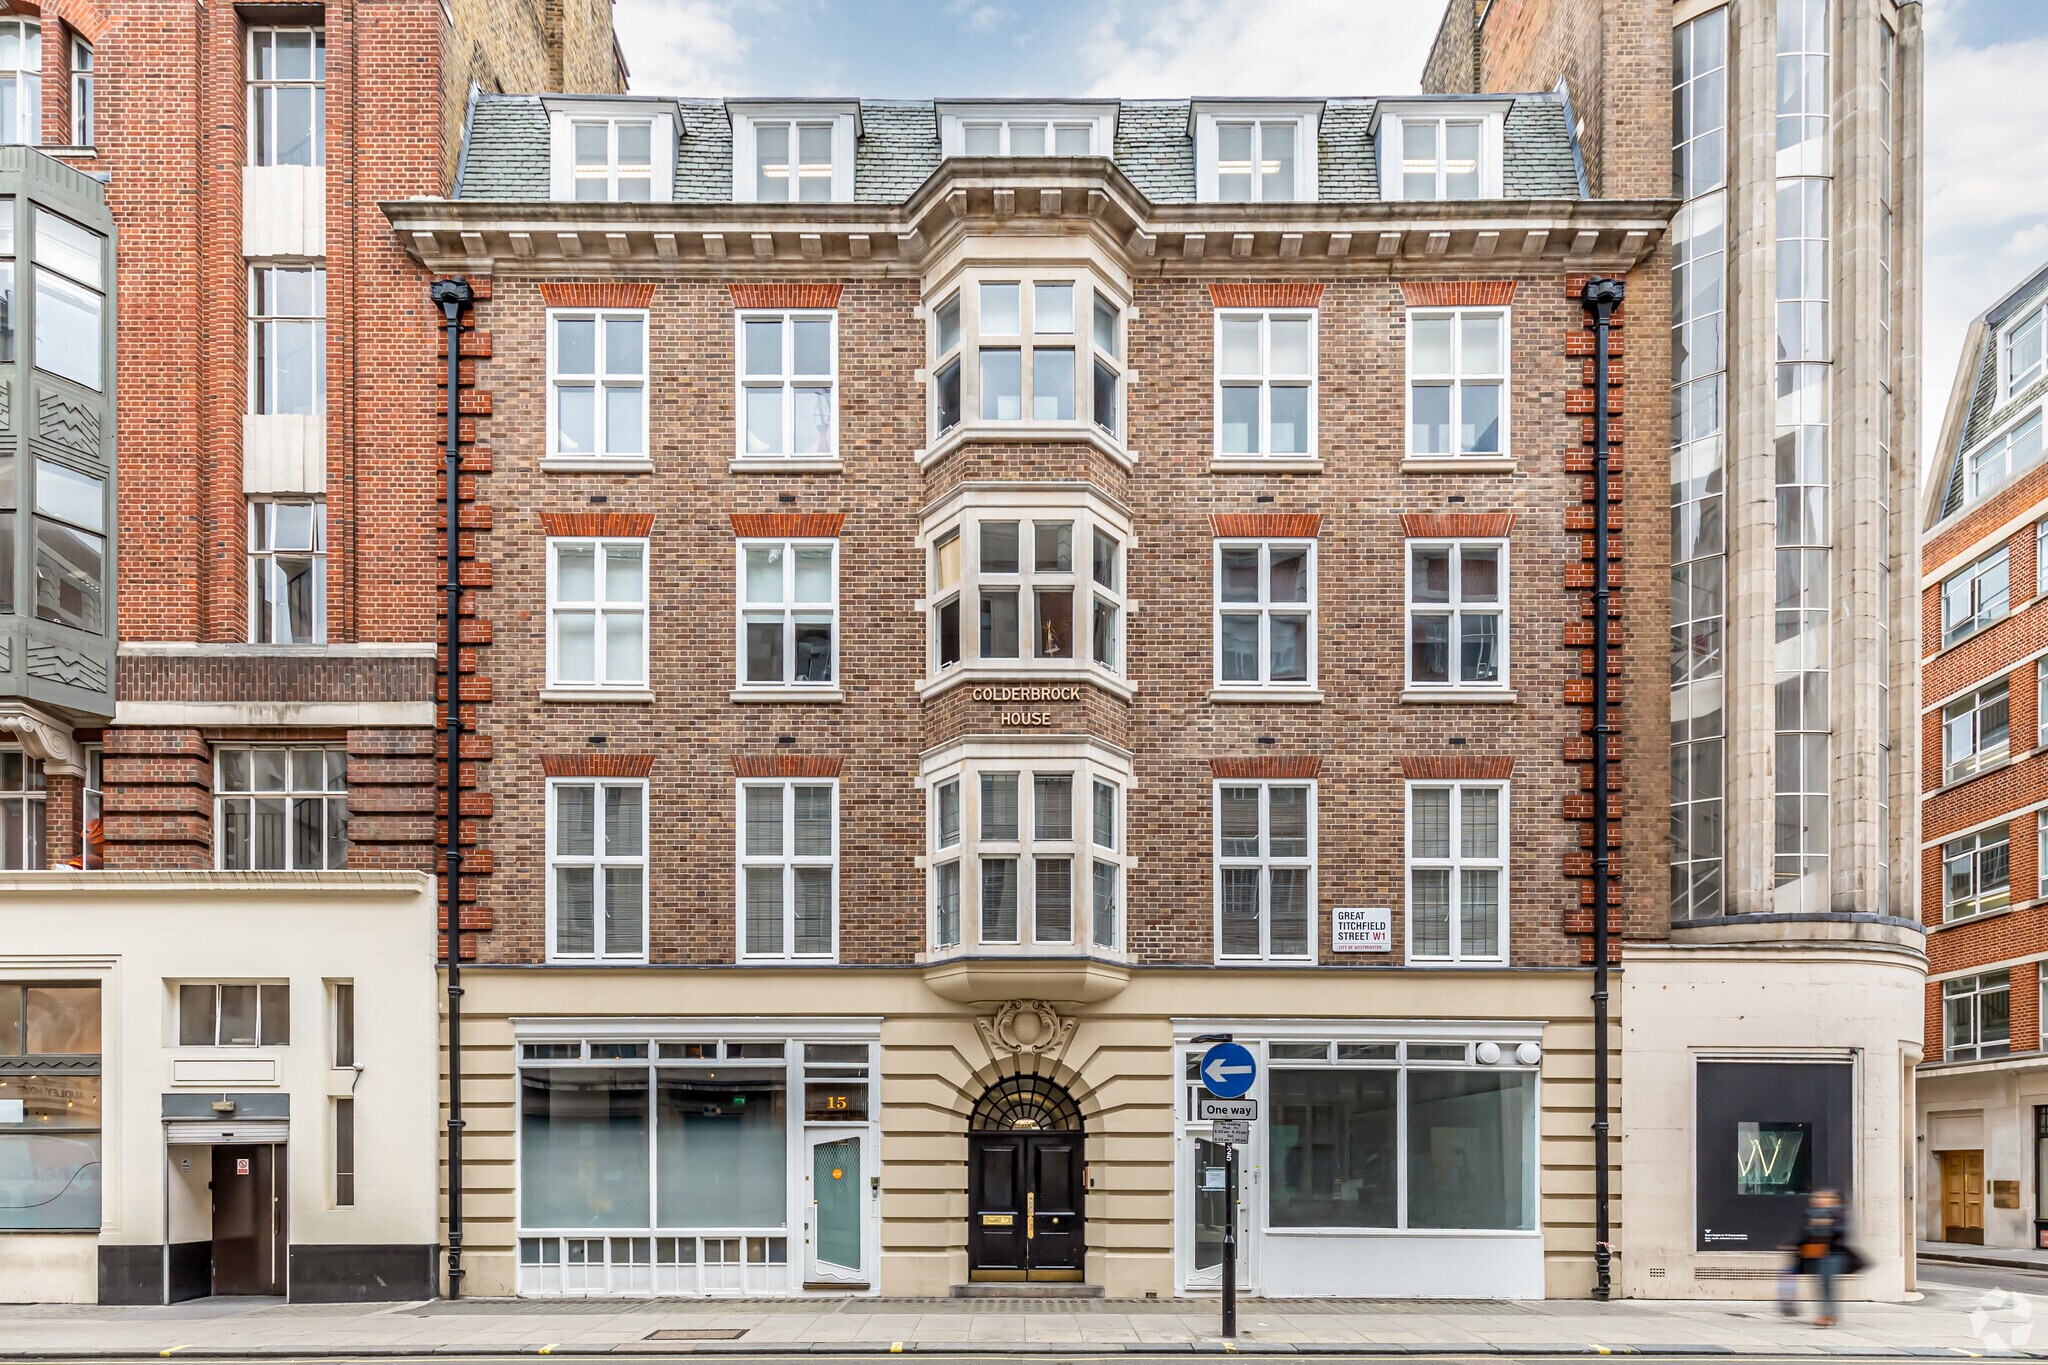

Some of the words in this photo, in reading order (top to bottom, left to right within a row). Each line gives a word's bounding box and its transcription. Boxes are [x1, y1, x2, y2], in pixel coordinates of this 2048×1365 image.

[973, 687, 1080, 701] GOLDERBROCK
[1001, 712, 1051, 725] HOUSE
[1338, 911, 1365, 920] GREAT
[1338, 921, 1386, 930] TITCHFIELD
[1338, 932, 1370, 940] STREET
[1373, 932, 1385, 940] W1
[827, 1096, 847, 1109] 15
[1207, 1105, 1228, 1114] One
[1231, 1107, 1251, 1116] way
